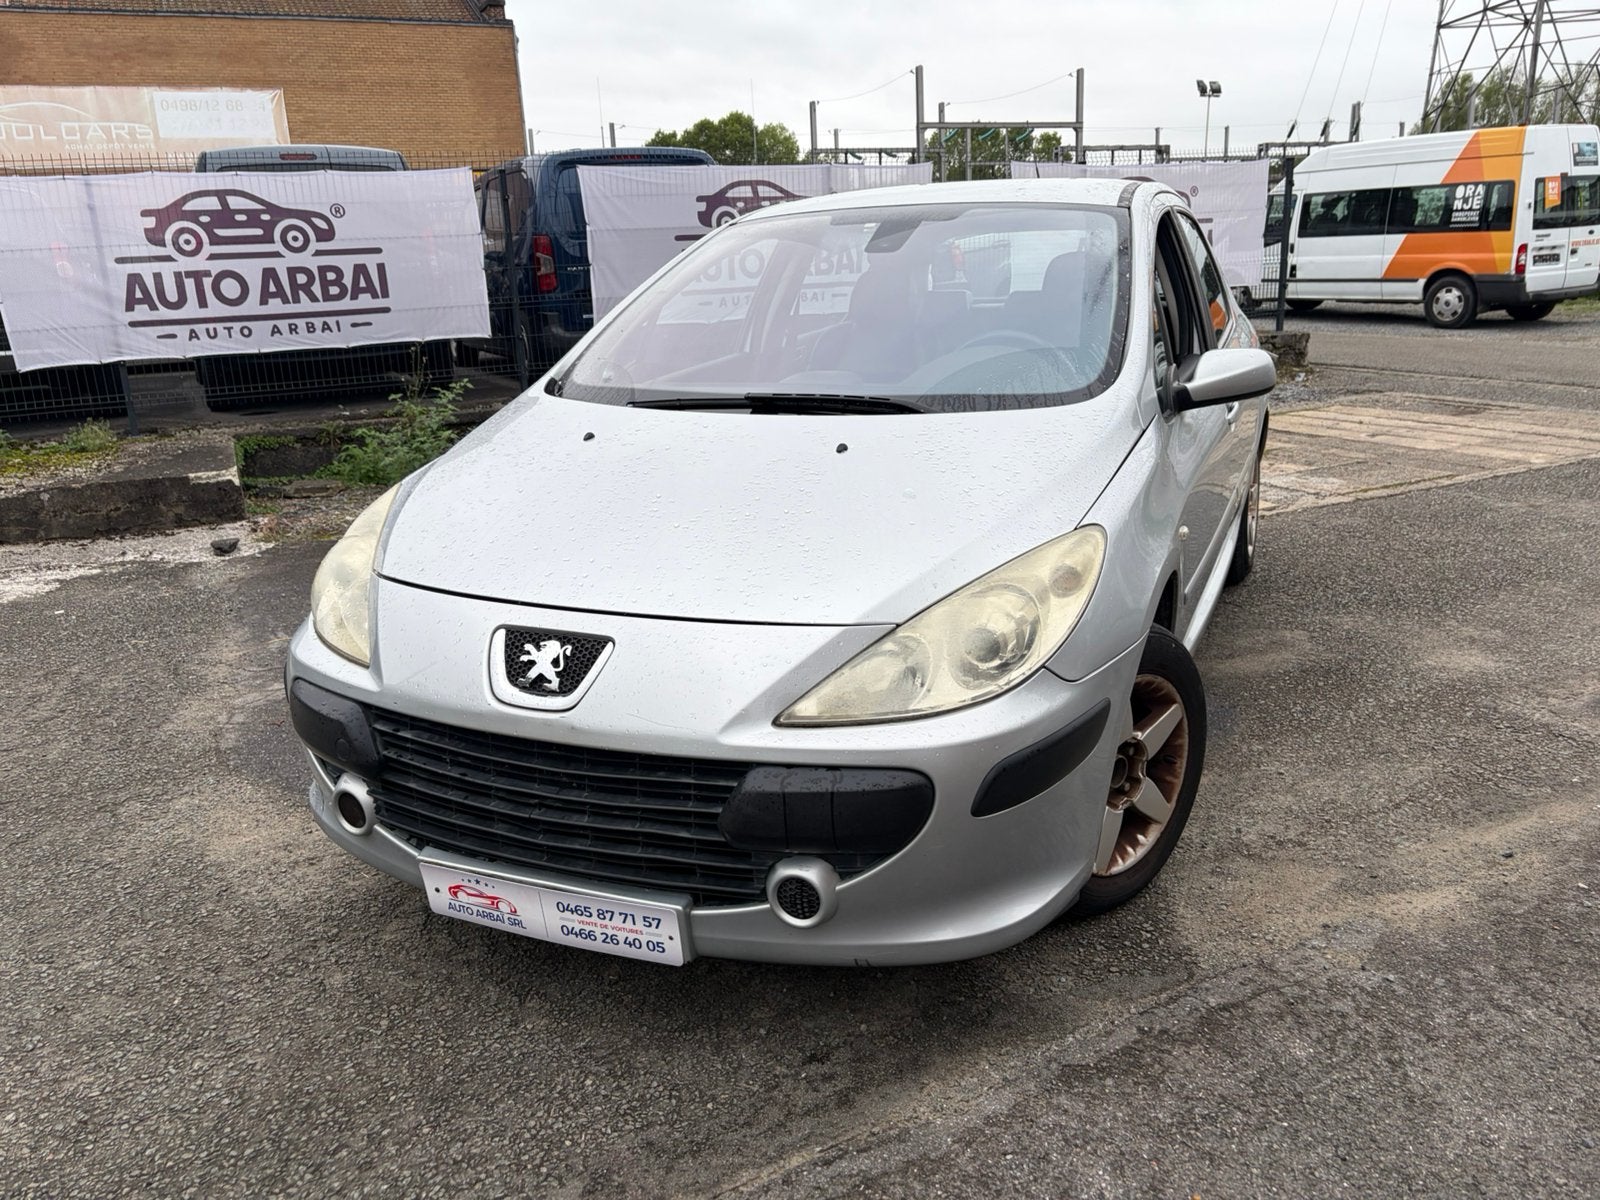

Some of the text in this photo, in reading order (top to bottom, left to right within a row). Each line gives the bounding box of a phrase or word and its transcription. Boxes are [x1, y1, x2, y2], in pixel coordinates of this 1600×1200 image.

[124, 262, 390, 312] AUTO ARBAI
[188, 319, 342, 342] AUTO ARBAI
[448, 901, 474, 916] AUTO
[507, 916, 527, 930] SRL
[556, 901, 662, 930] 0465 87 71 57
[576, 919, 644, 936] VENTE DE VOITURES
[560, 924, 666, 954] 0466 26 40 05
